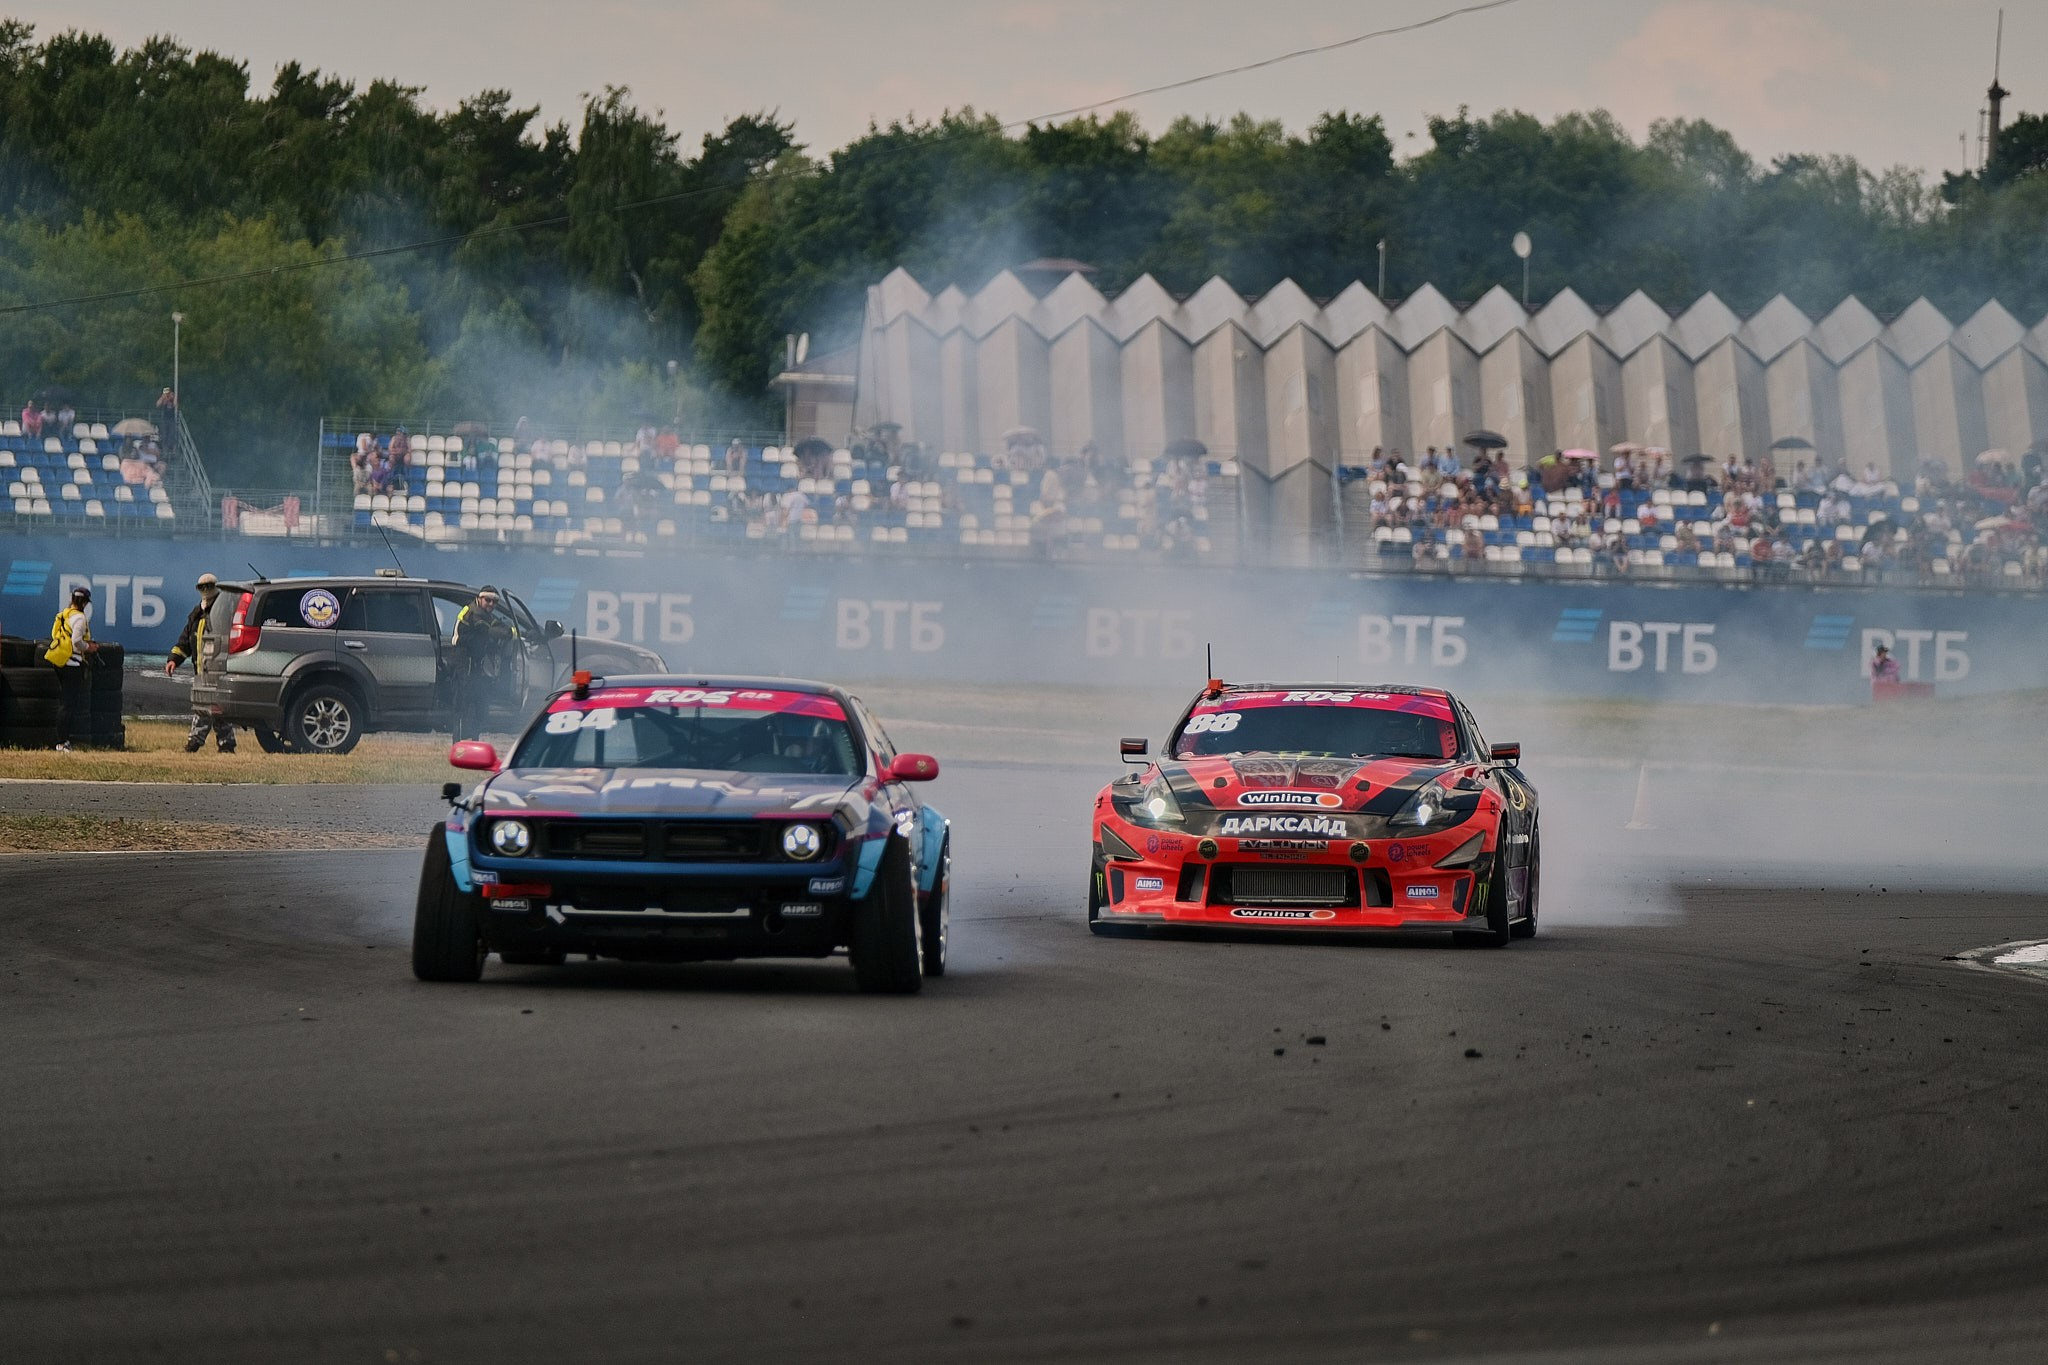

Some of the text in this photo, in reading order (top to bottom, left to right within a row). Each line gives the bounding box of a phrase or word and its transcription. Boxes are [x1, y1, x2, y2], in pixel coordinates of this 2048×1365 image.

[59, 574, 166, 628] ВТБ
[586, 590, 695, 644] ВТБ
[837, 598, 945, 652] ВТБ
[1086, 607, 1195, 659] ВТБ
[1359, 614, 1468, 667] ВТБ
[1608, 620, 1718, 674] ВТБ
[1861, 627, 1970, 681] ВТБ
[644, 689, 739, 704] RDS
[1281, 691, 1361, 702] RDS
[545, 707, 618, 734] 84
[1183, 713, 1242, 734] 88
[1247, 793, 1313, 803] Winline
[1221, 815, 1347, 837] ДАРКСАЙД
[1238, 839, 1329, 850] EVOLUTION
[1240, 909, 1306, 918] Winline
